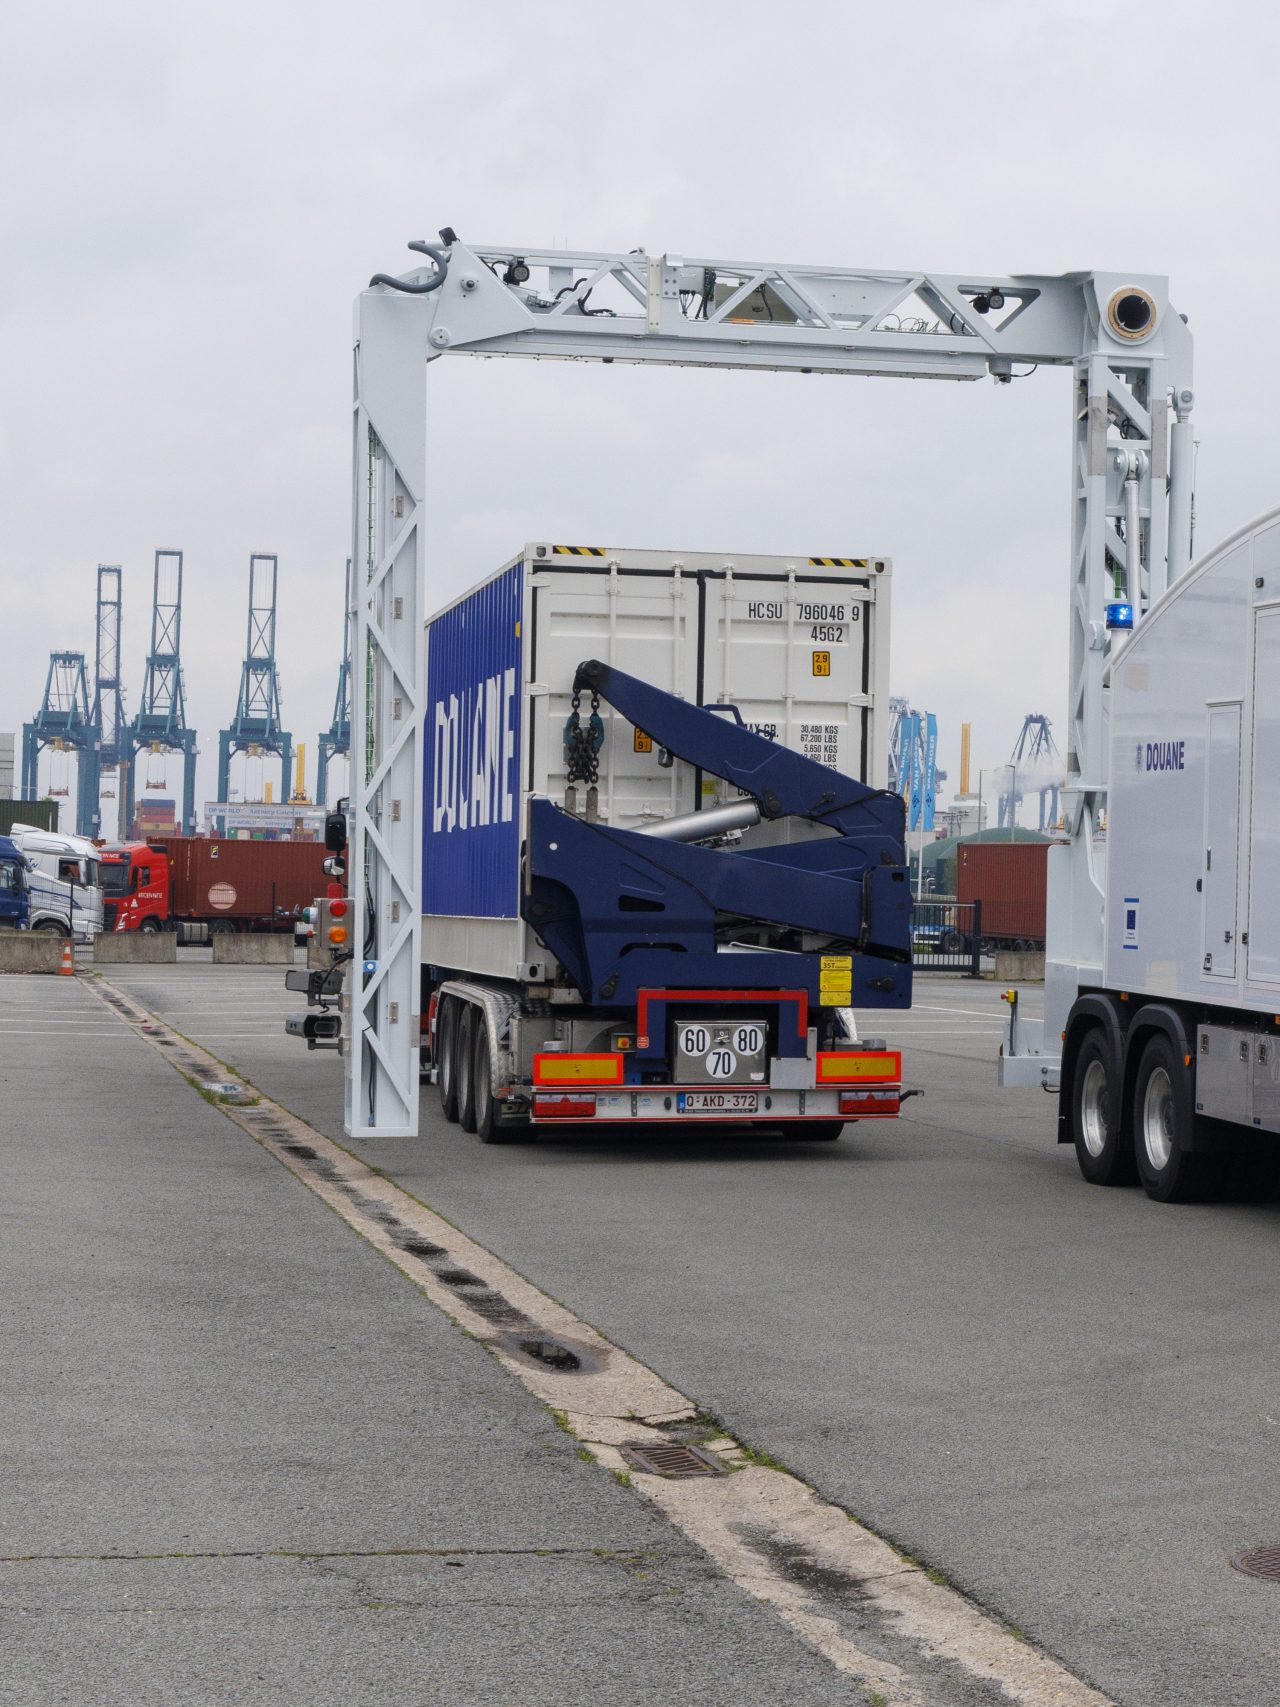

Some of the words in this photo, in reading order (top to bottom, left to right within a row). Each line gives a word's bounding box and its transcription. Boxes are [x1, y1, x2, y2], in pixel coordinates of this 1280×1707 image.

[748, 602, 783, 619] HCSU
[796, 603, 845, 621] 796046
[851, 605, 860, 622] 9
[810, 625, 844, 643] 45G2
[815, 654, 828, 664] 2.9
[800, 724, 823, 735] 30,480
[824, 725, 839, 735] KGS
[800, 734, 822, 743] 67,200
[824, 735, 838, 744] LBS
[433, 668, 516, 833] DOUANE
[823, 754, 837, 763] LBS
[824, 744, 838, 754] KGS
[1146, 741, 1185, 771] DOUANE
[685, 1028, 706, 1053] 60
[738, 1028, 758, 1052] 80
[712, 1051, 731, 1076] 70
